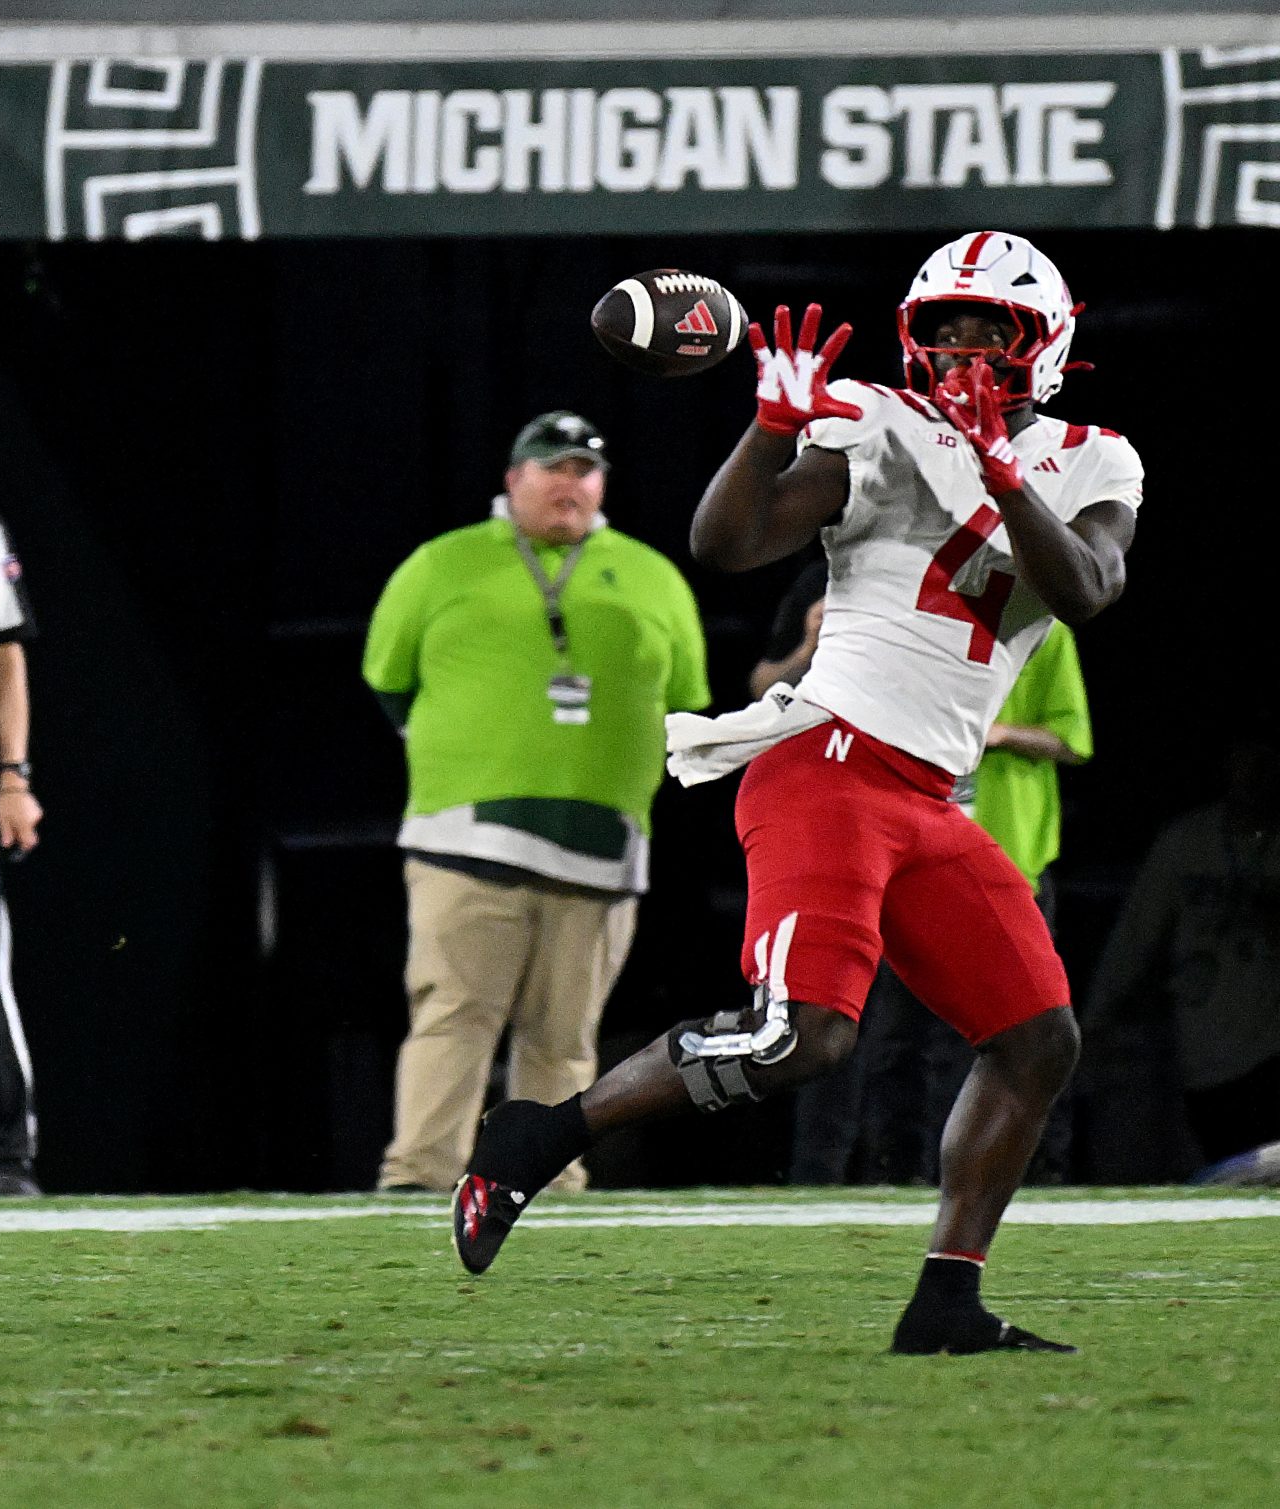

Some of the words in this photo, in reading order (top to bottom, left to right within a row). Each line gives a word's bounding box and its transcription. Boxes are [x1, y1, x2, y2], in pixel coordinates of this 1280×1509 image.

[304, 88, 801, 194] MICHIGAN
[821, 82, 1116, 188] STATE
[757, 345, 825, 412] N
[915, 503, 1016, 665] 4
[824, 728, 855, 763] N
